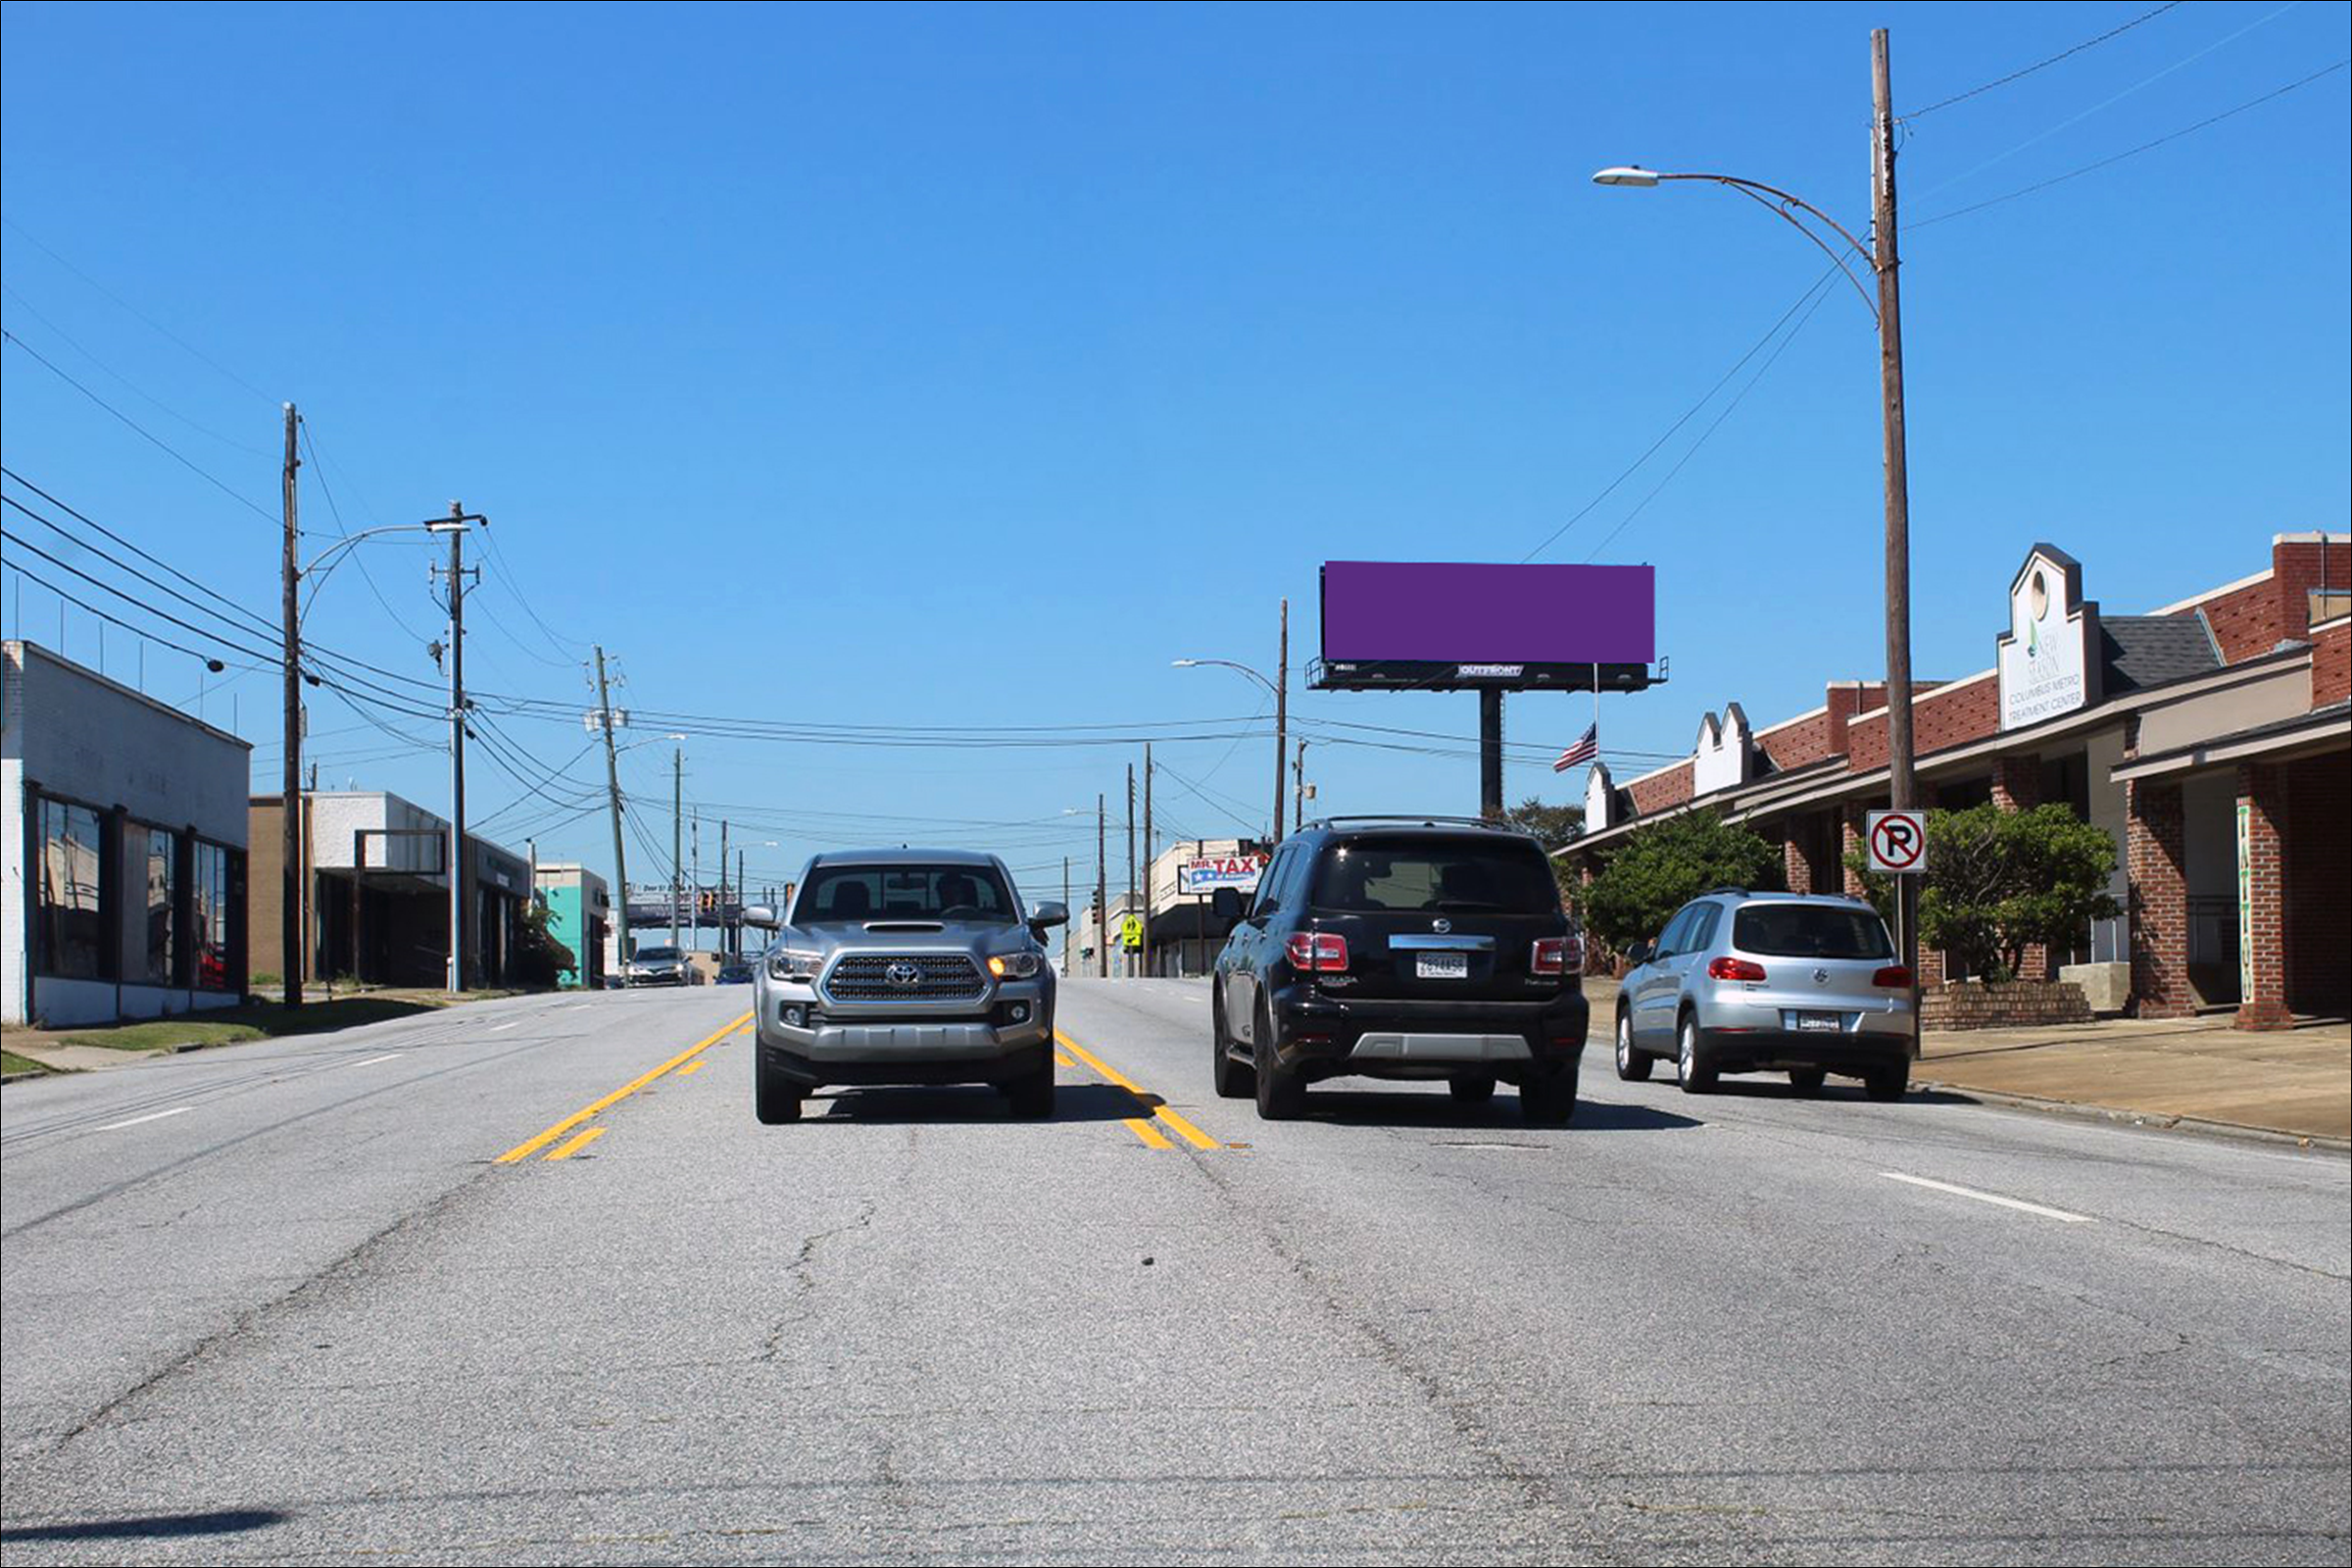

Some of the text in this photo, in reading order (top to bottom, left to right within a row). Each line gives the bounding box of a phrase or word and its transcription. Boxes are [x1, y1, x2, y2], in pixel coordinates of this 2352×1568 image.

[1460, 665, 1522, 676] OUTFRONT
[2009, 673, 2081, 705] COLUMBUS METRO
[2009, 691, 2082, 722] TREATMENT CENTER
[1887, 825, 1912, 857] P
[1191, 858, 1255, 875] MR. TAX
[2238, 808, 2252, 1002] TATTOO
